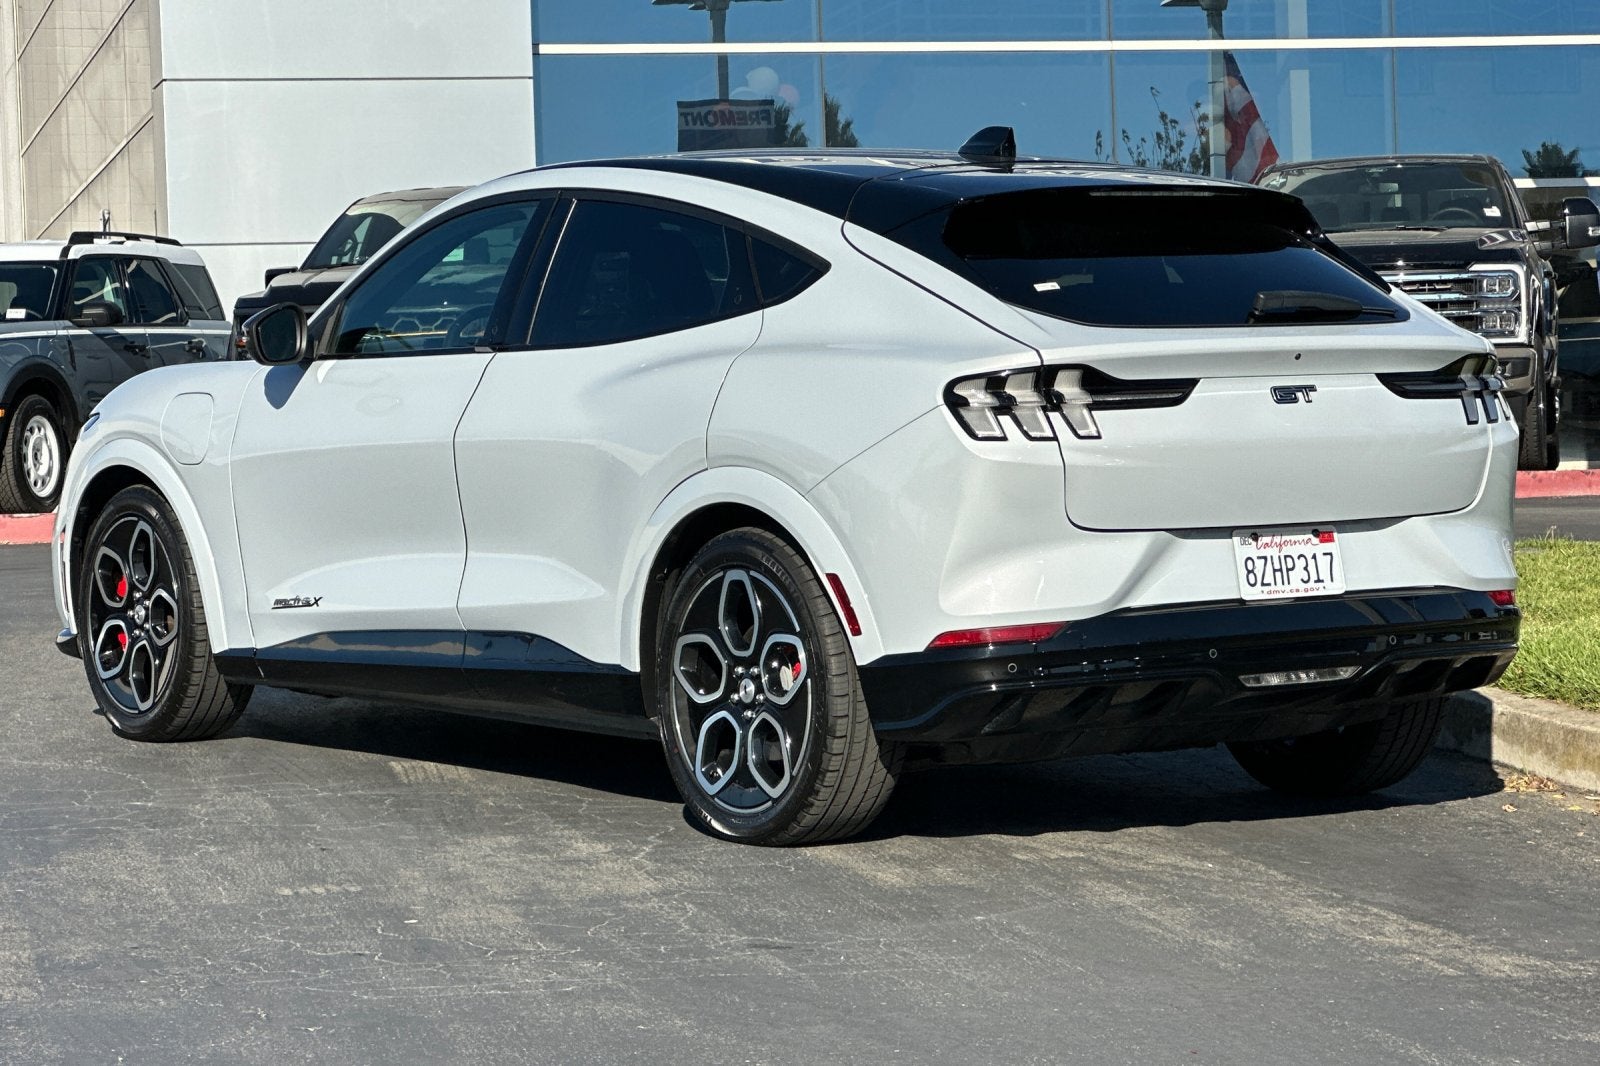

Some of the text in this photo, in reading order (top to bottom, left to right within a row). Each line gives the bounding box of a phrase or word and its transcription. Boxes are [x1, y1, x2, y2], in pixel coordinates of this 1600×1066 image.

[1270, 384, 1317, 404] GT
[1256, 533, 1320, 554] California
[1244, 552, 1335, 588] 8ZHP317
[1266, 585, 1321, 595] dmv.ca.gov
